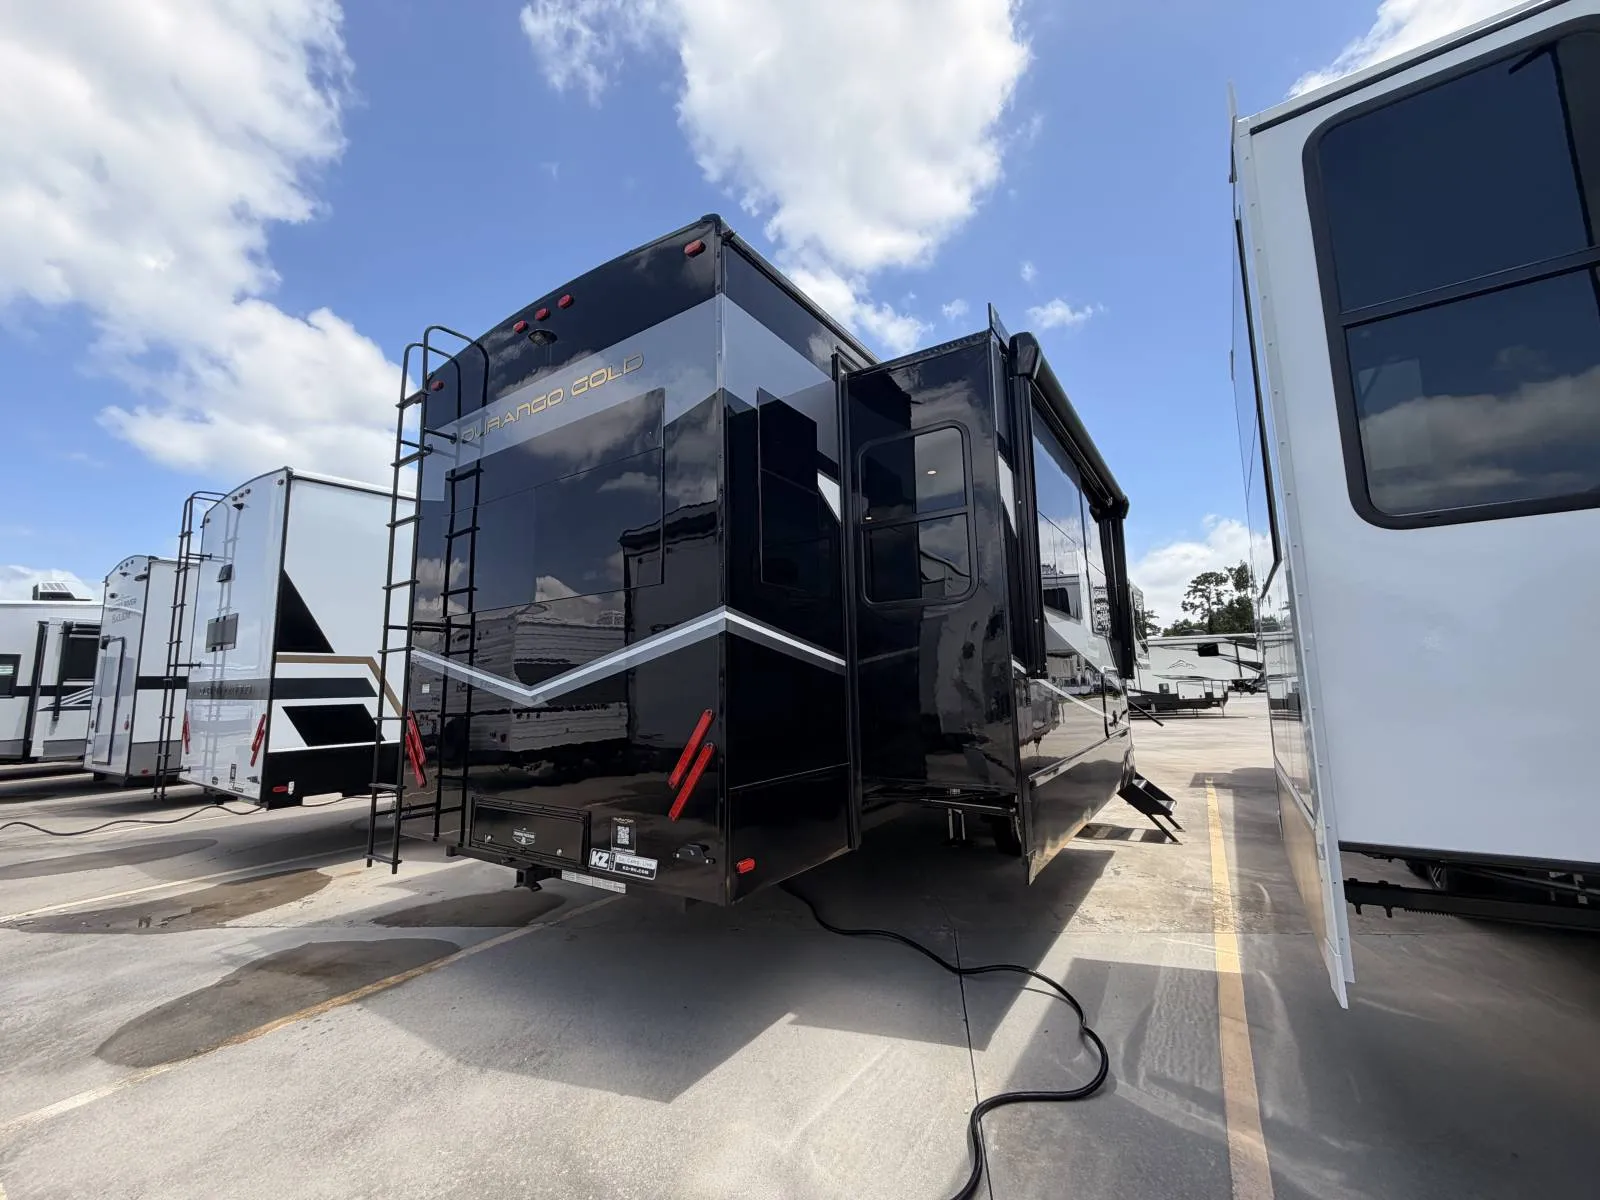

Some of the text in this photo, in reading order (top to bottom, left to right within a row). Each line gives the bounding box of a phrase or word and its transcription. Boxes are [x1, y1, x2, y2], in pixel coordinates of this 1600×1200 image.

[461, 353, 644, 442] DURANGO GOLD
[590, 850, 610, 868] KZ
